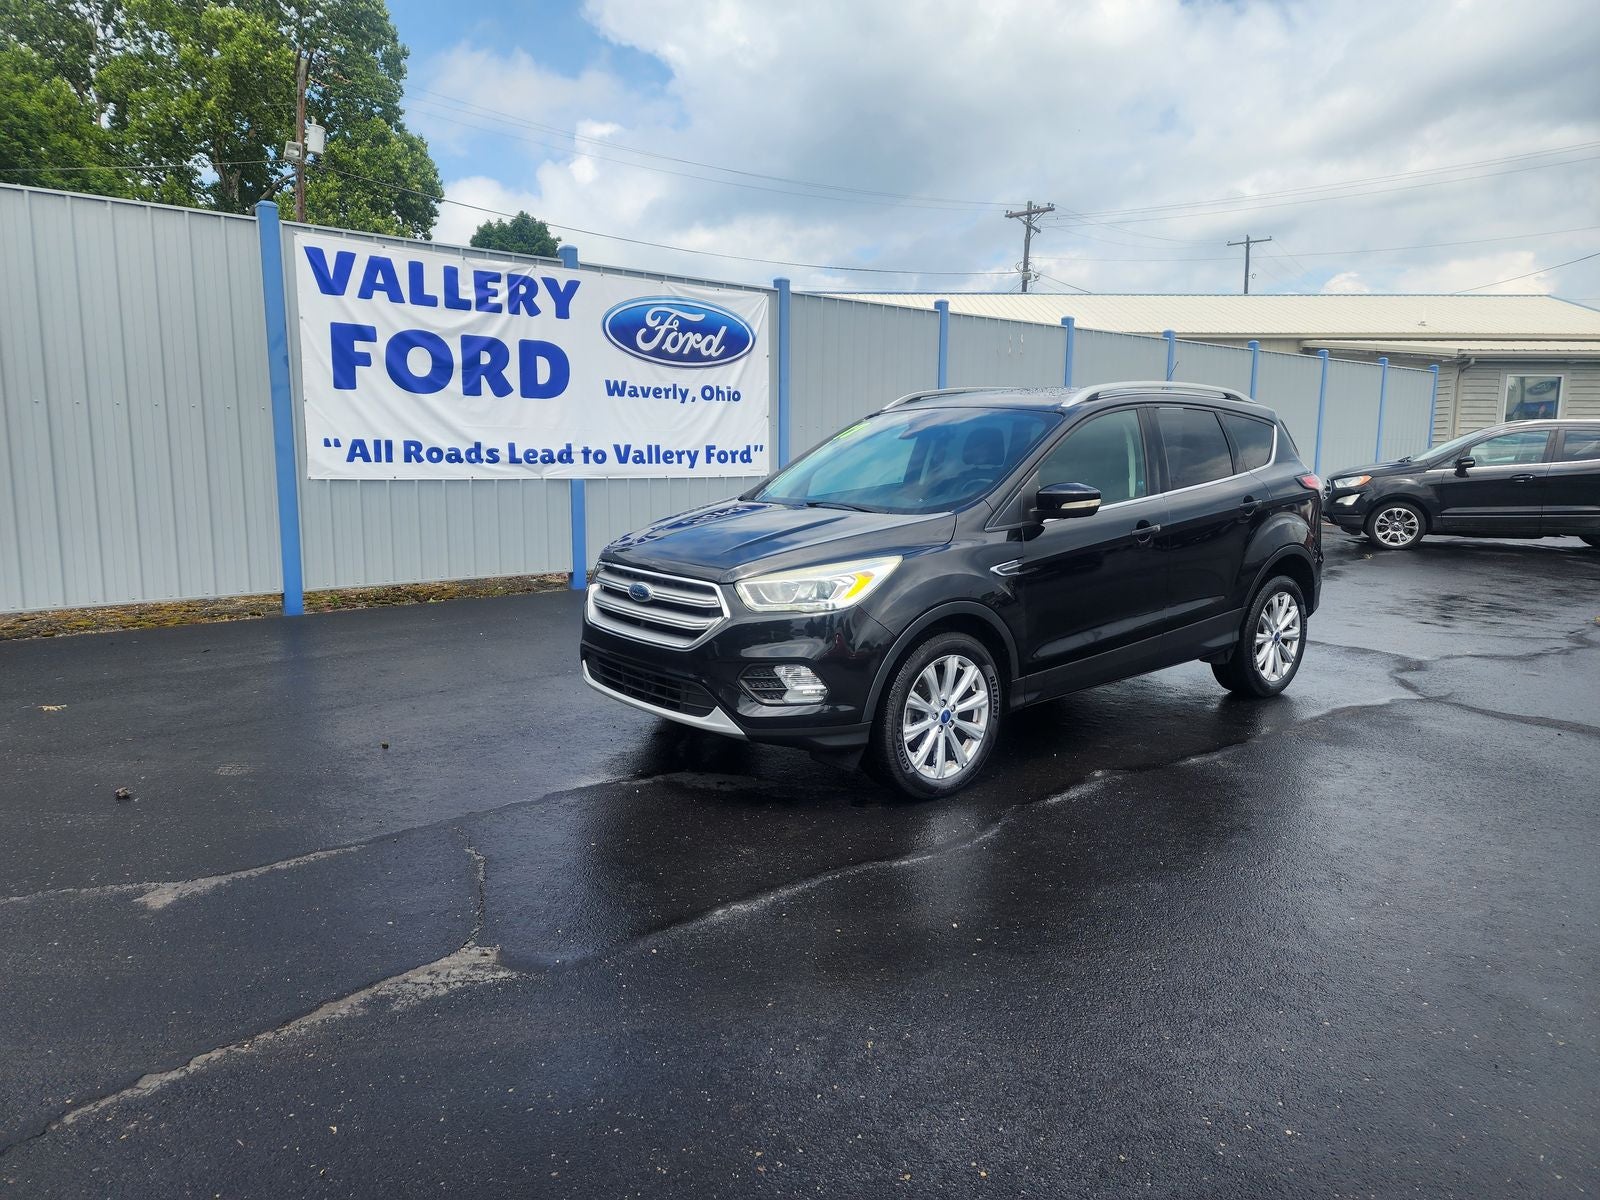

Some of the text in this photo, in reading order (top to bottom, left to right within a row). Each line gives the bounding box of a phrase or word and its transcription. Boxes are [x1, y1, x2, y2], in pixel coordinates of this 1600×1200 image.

[303, 245, 581, 320] VALLERY
[635, 306, 728, 358] Ford
[329, 321, 571, 400] FORD
[604, 379, 742, 403] Waverly, Ohio
[402, 439, 501, 465] Roads
[507, 442, 575, 465] Lead
[581, 447, 608, 465] to
[612, 443, 699, 469] Vallery
